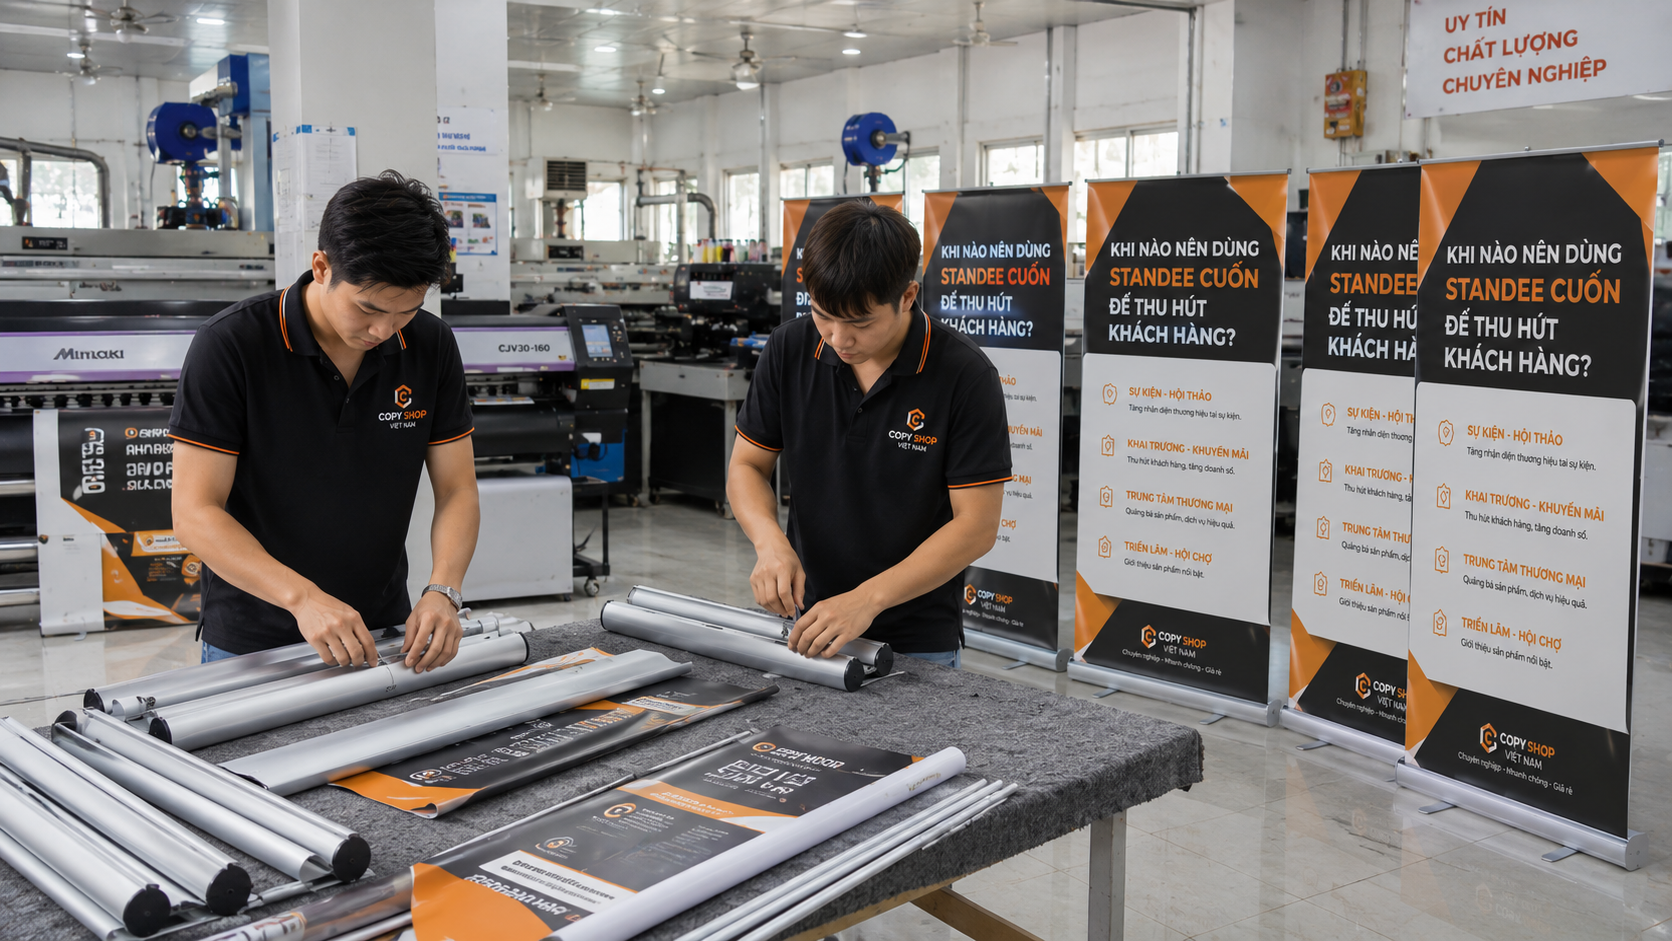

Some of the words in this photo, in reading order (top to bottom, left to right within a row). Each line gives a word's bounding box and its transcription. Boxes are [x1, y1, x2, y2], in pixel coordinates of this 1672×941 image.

[1445, 14, 1470, 33] UY
[1475, 6, 1507, 28] TÍN
[1443, 37, 1497, 64] CHẤT
[1502, 29, 1578, 57] LƯỢNG
[1442, 67, 1521, 94] CHUYÊN
[1527, 56, 1607, 84] NGHIỆP
[942, 245, 959, 258] KHI
[963, 241, 987, 258] NÀO
[990, 241, 1013, 258] NÊN
[1017, 240, 1050, 258] DÙNG
[1110, 242, 1135, 257] KHI
[1139, 238, 1171, 257] NÀO
[1176, 237, 1207, 256] NÊN
[1213, 237, 1259, 256] DÙNG
[1331, 245, 1356, 261] KHI
[1360, 240, 1393, 261] NÀO
[1447, 246, 1474, 264] KHI
[1480, 240, 1517, 264] NÀO
[1523, 240, 1559, 263] NÊN
[1566, 239, 1622, 263] DÙNG
[941, 268, 1004, 285] STANDEE
[1008, 261, 1050, 285] CUỐN
[1110, 267, 1194, 287] STANDEE
[1200, 261, 1258, 288] CUỐN
[1330, 272, 1417, 295] STANDEE
[1446, 278, 1544, 302] STANDEE
[1551, 269, 1621, 304] CUỐN
[959, 295, 984, 311] THU
[988, 292, 1012, 311] HÚT
[1134, 299, 1167, 316] THU
[1172, 295, 1207, 317] HÚT
[989, 316, 1033, 337] HÀNG?
[1355, 308, 1388, 328] THU
[1474, 316, 1511, 338] THU
[1518, 312, 1558, 340] HÚT
[1109, 320, 1168, 343] KHÁCH
[1174, 322, 1236, 346] HÀNG?
[53, 348, 124, 360] Mimaki
[498, 344, 550, 352] CJV30-160
[1328, 333, 1388, 359] KHÁCH
[1445, 343, 1512, 372] KHÁCH
[1519, 346, 1592, 377] HÀNG?
[378, 412, 402, 421] COPY
[404, 410, 427, 420] SHOP
[888, 430, 912, 441] COPY
[914, 434, 937, 445] SHOP
[1127, 439, 1147, 449] KHAI
[1150, 441, 1185, 453] TRƯƠNG
[1482, 425, 1504, 441] KIỆN
[1534, 430, 1563, 446] THẢO
[1345, 465, 1364, 476] KHAI
[1126, 491, 1154, 502] TRUNG
[1465, 490, 1487, 503] KHAI
[1490, 493, 1530, 509] TRƯƠNG
[1539, 501, 1581, 518] KHUYẾN
[1342, 522, 1370, 536] TRUNG
[1465, 511, 1477, 521] Thu
[1552, 526, 1576, 538] doanh
[1463, 554, 1495, 570] TRUNG
[1520, 565, 1563, 583] THƯƠNG
[1566, 573, 1586, 590] MẠI
[977, 590, 995, 600] COPY
[1158, 631, 1181, 644] COPY
[1183, 636, 1206, 648] SHOP
[1518, 630, 1536, 646] HỘI
[1539, 635, 1562, 653] CHỢ
[1373, 681, 1396, 695] COPY
[1500, 733, 1526, 749] COPY
[1528, 741, 1555, 758] SHOP
[1523, 757, 1542, 770] NAM
